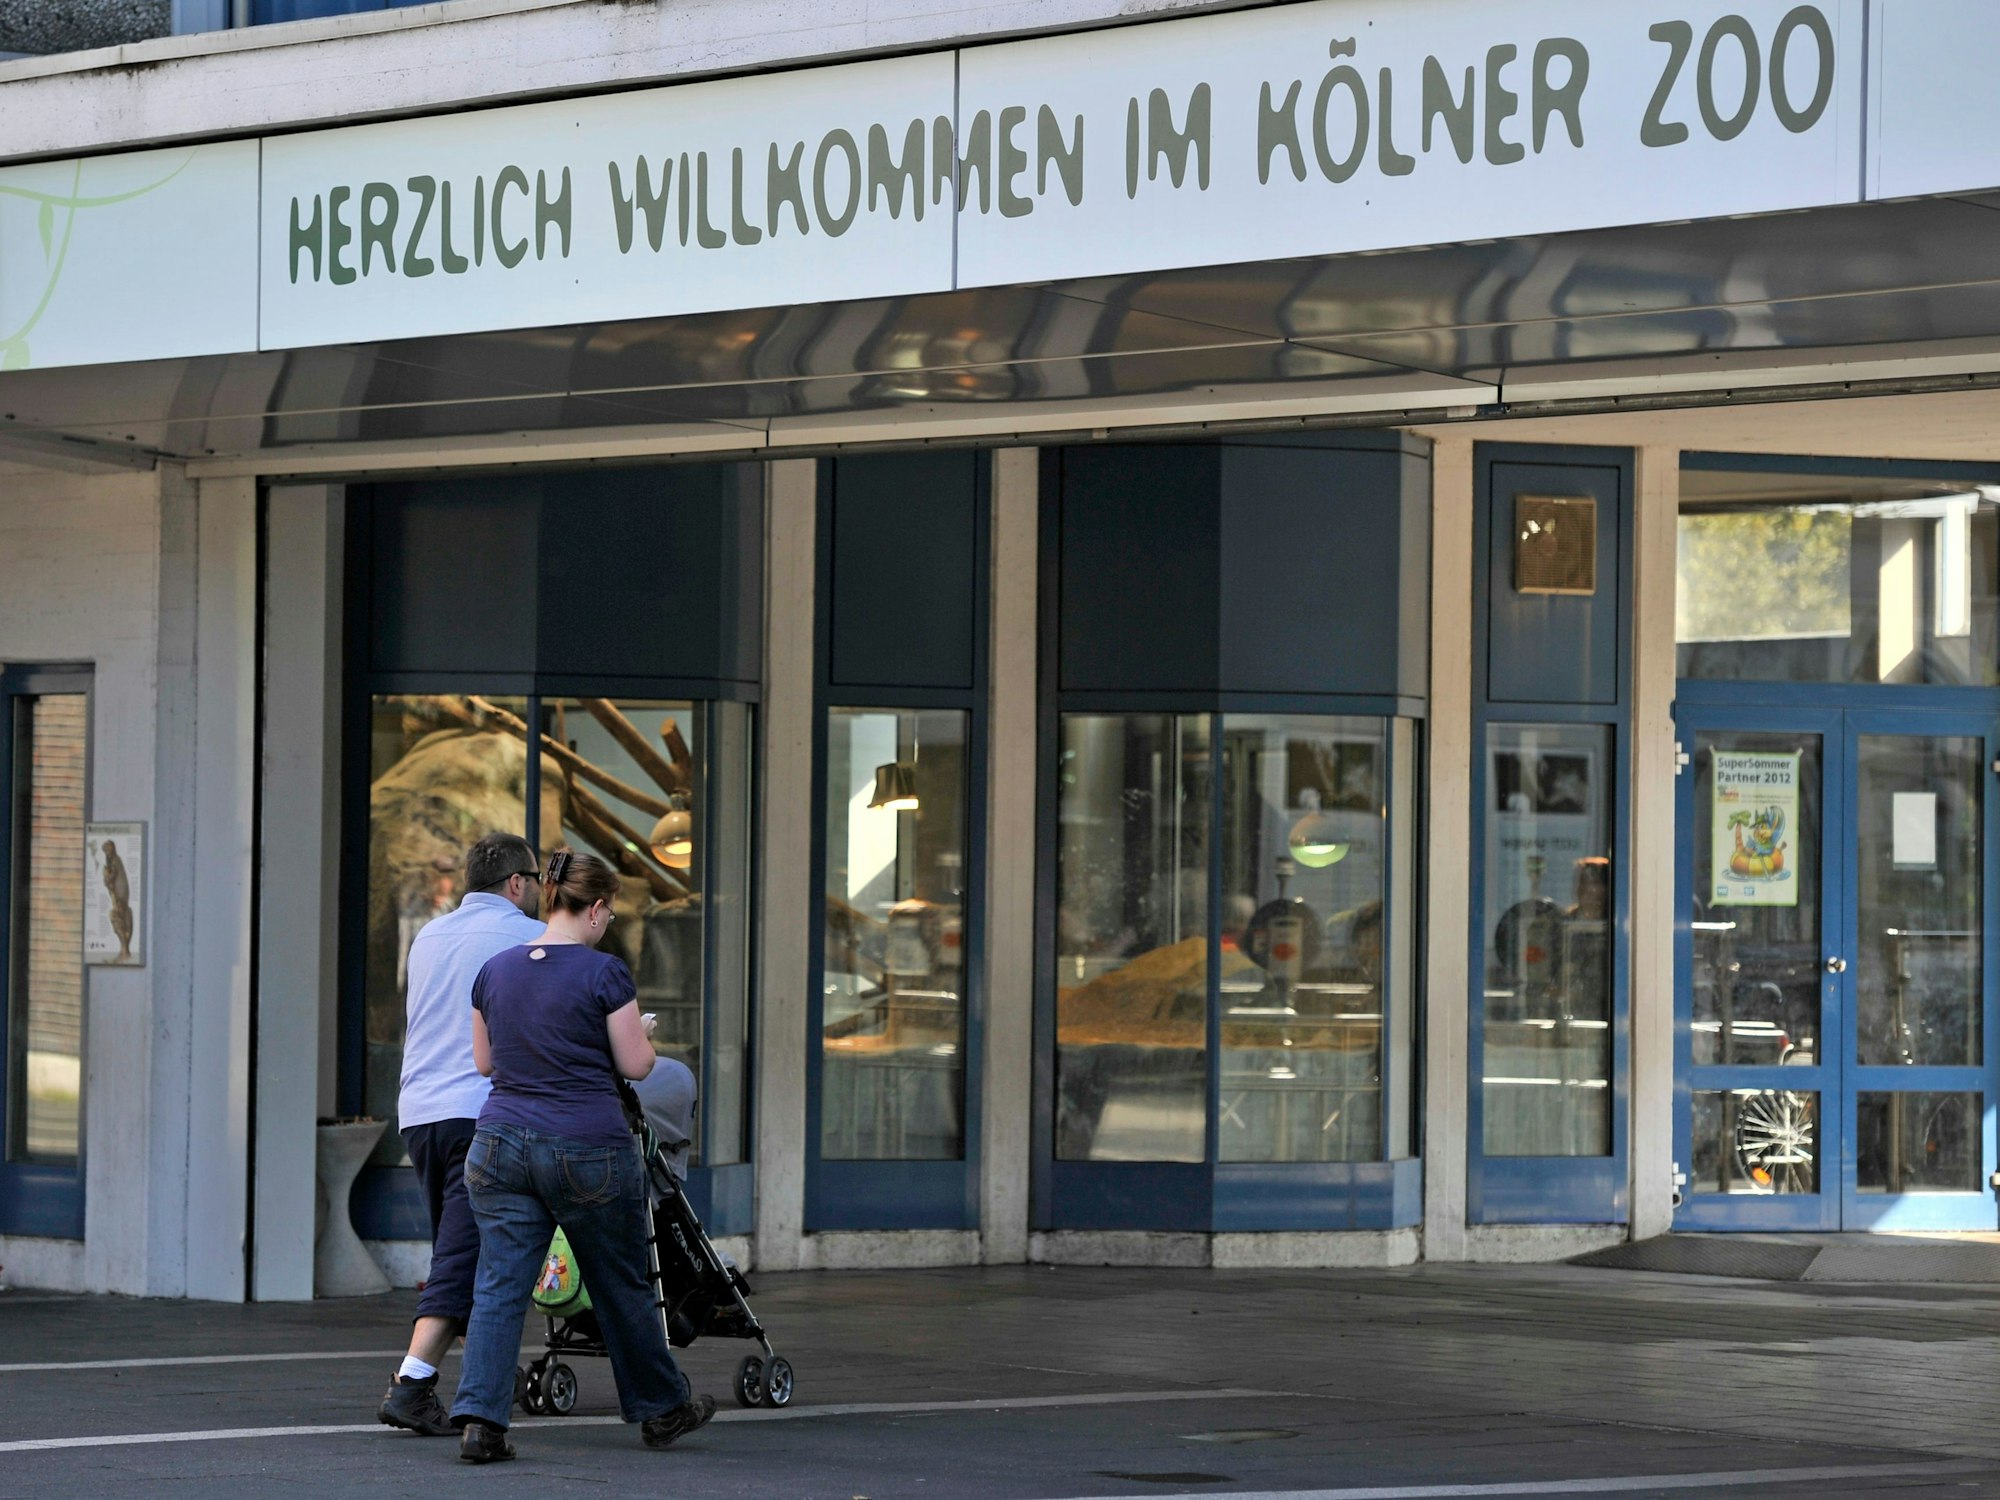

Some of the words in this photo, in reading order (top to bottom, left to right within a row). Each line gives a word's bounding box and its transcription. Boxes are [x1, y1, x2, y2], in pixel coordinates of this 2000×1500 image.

[288, 164, 572, 286] HERZLICH
[608, 103, 1085, 255] WILLKOMMEN
[1125, 80, 1212, 200] IM
[1257, 36, 1590, 186] KÖLNER
[1639, 4, 1836, 148] ZOO
[1717, 757, 1791, 771] SuperSommer
[1717, 771, 1761, 784] Partner
[1764, 772, 1792, 784] 2012
